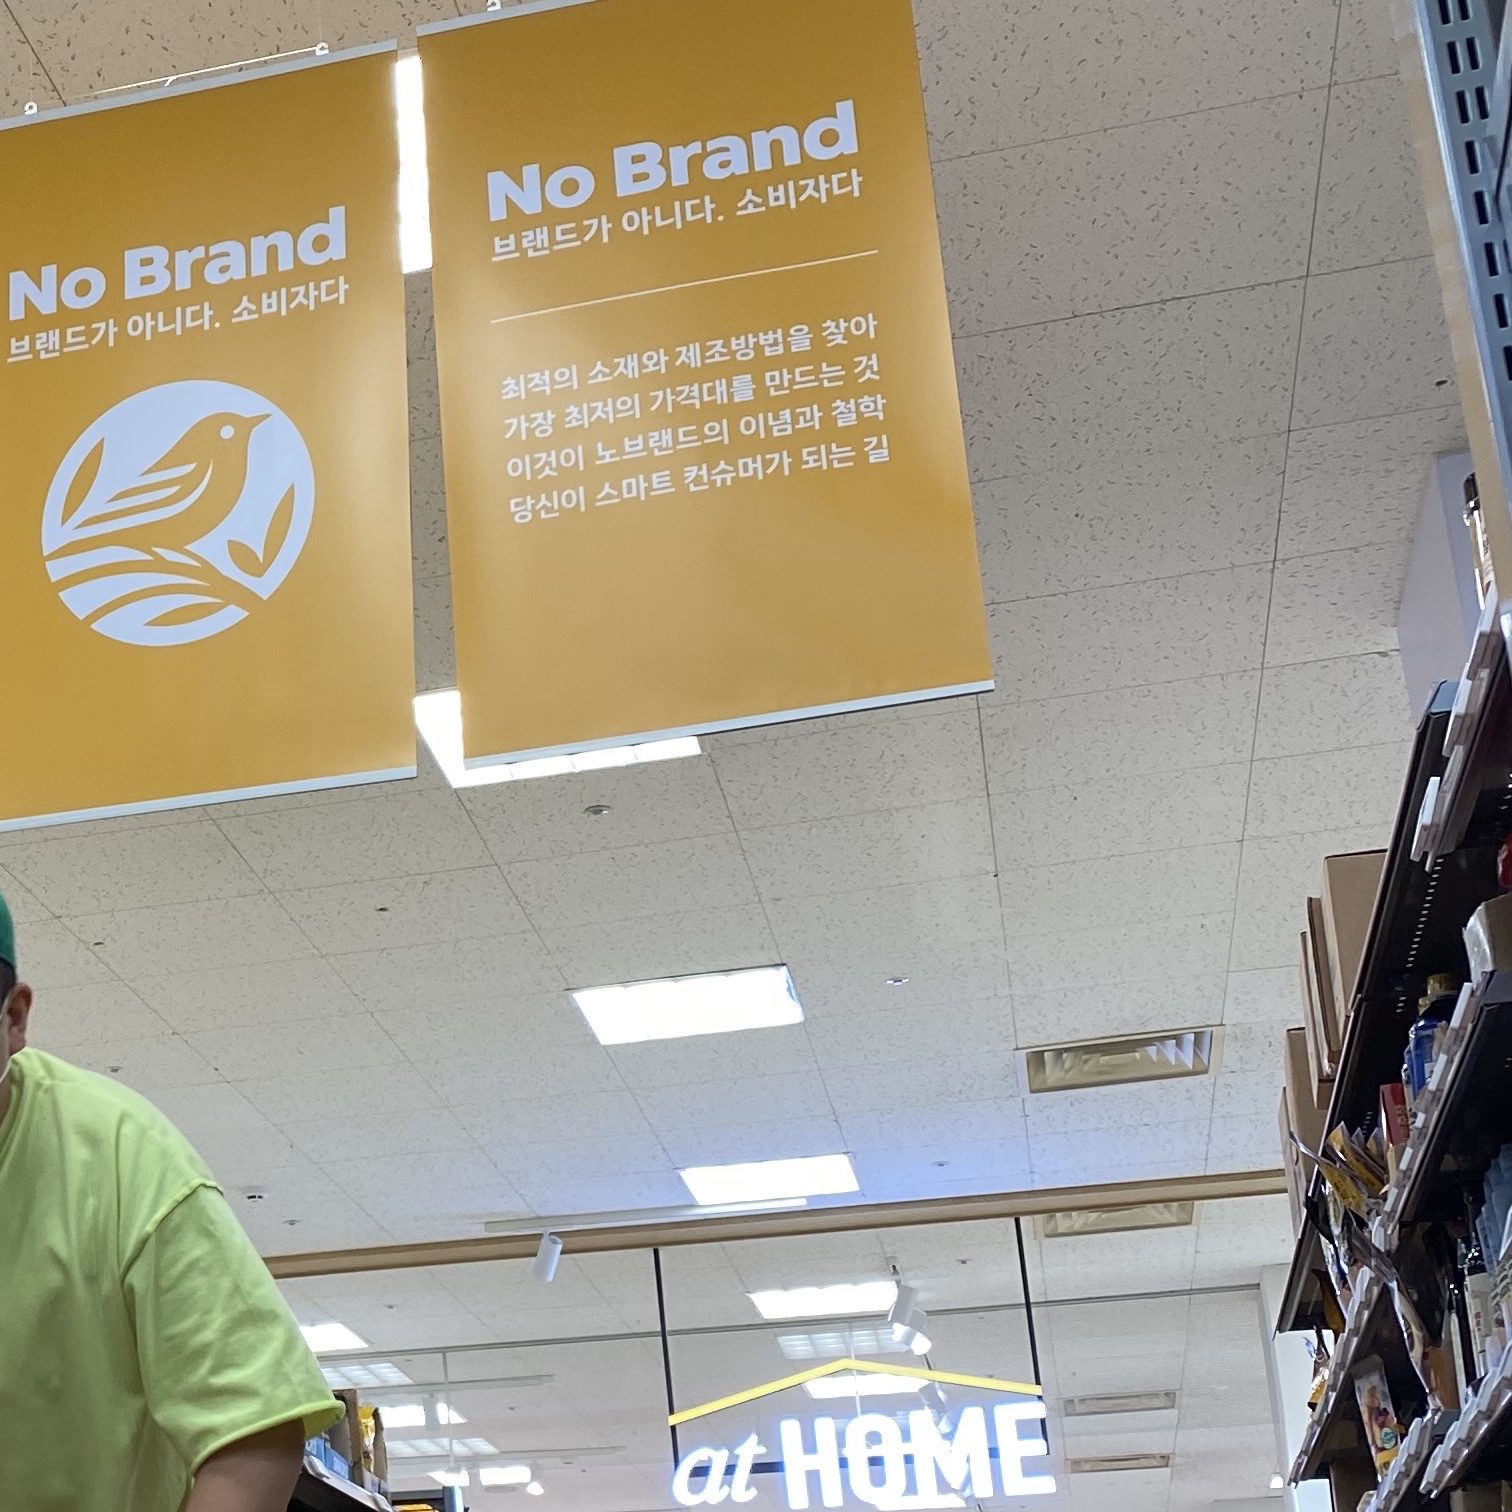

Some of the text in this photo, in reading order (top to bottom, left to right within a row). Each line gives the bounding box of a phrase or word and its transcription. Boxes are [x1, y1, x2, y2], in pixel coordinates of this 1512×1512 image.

[487, 98, 859, 222] No Brand
[491, 168, 863, 262] 브랜드가 아니다. 소비자다
[8, 205, 347, 321] No Brand
[7, 276, 349, 363] 브랜드가 아니다. 소비자다
[500, 312, 878, 401] 최적의 소재와 제조방법을 찾아
[503, 353, 881, 442] 가장 최저의 가격대를 만드는 것
[506, 393, 887, 482] 이것이 노브랜드의 이념과 철학
[508, 433, 890, 524] 당신이 스마트 컨슈머가 되는 길
[671, 1400, 1057, 1512] at HOME
